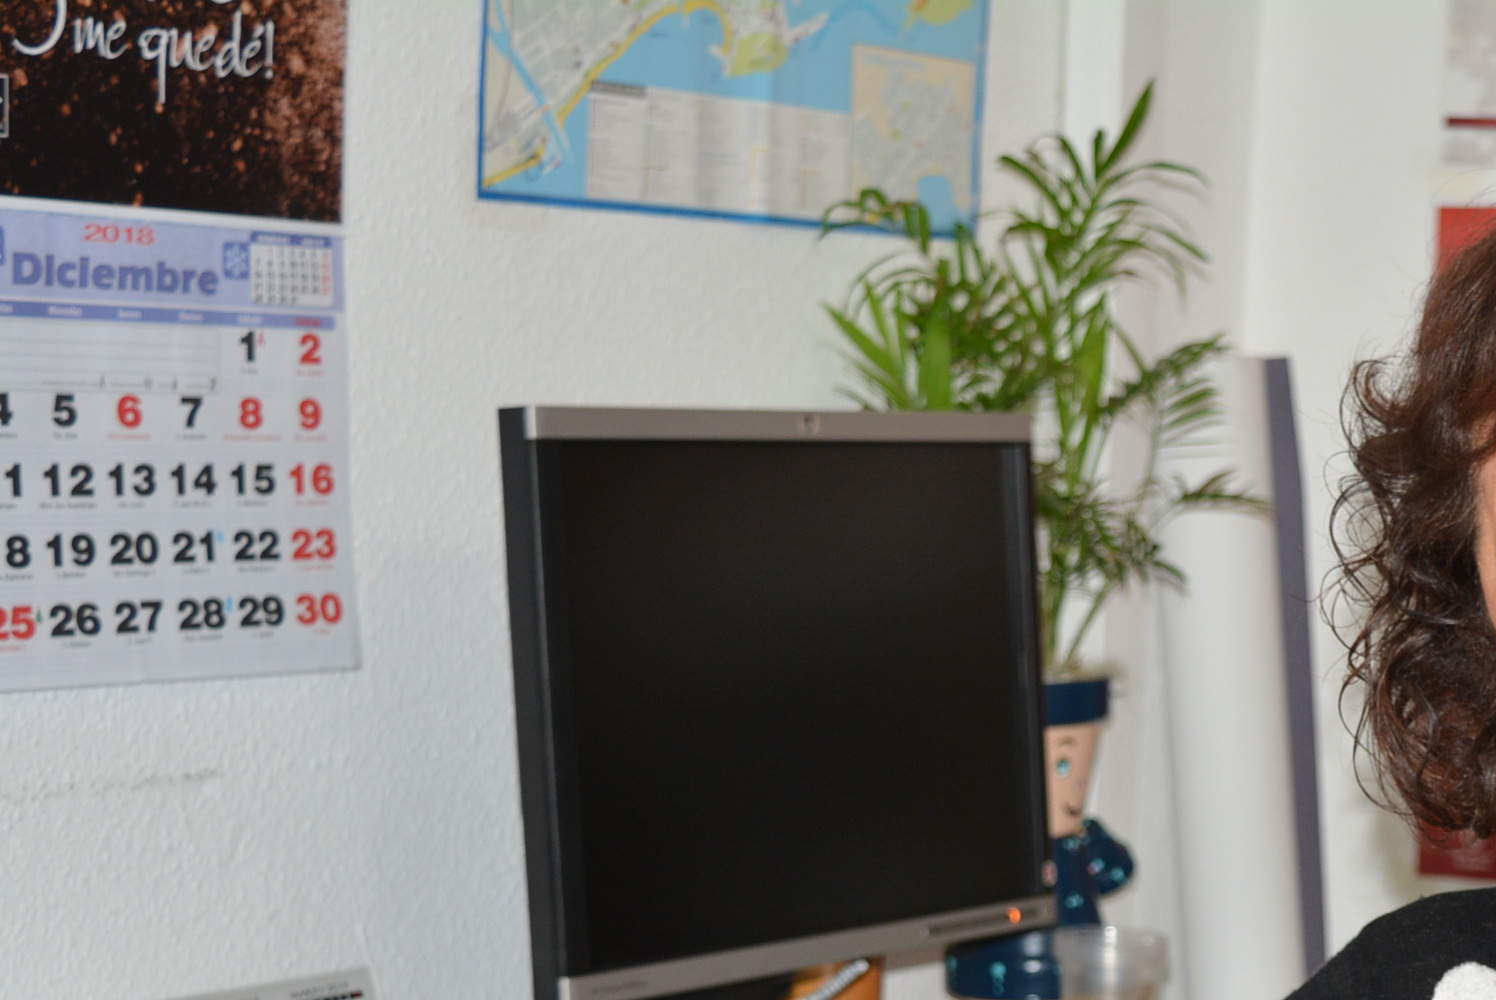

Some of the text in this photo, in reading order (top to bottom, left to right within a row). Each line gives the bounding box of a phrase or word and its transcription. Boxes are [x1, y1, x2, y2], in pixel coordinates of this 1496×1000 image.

[73, 16, 127, 60] me
[137, 9, 276, 105] quedé!
[83, 223, 155, 247] 2018
[11, 250, 220, 297] Diciembre
[240, 331, 323, 365] 1 2
[53, 394, 78, 427] 5
[117, 394, 143, 428] 6
[180, 396, 203, 428] 7
[239, 397, 263, 429] 8
[298, 398, 322, 430] 9
[43, 463, 95, 497] 12
[108, 463, 156, 496] 13
[170, 464, 217, 496] 14
[230, 464, 276, 496] 15
[288, 463, 335, 496] 16
[46, 532, 96, 568] 19
[109, 531, 159, 566] 20
[172, 531, 215, 564] 21
[233, 529, 281, 563] 22
[291, 528, 337, 561] 23
[0, 593, 343, 640] 25 26 27 28 29 30
